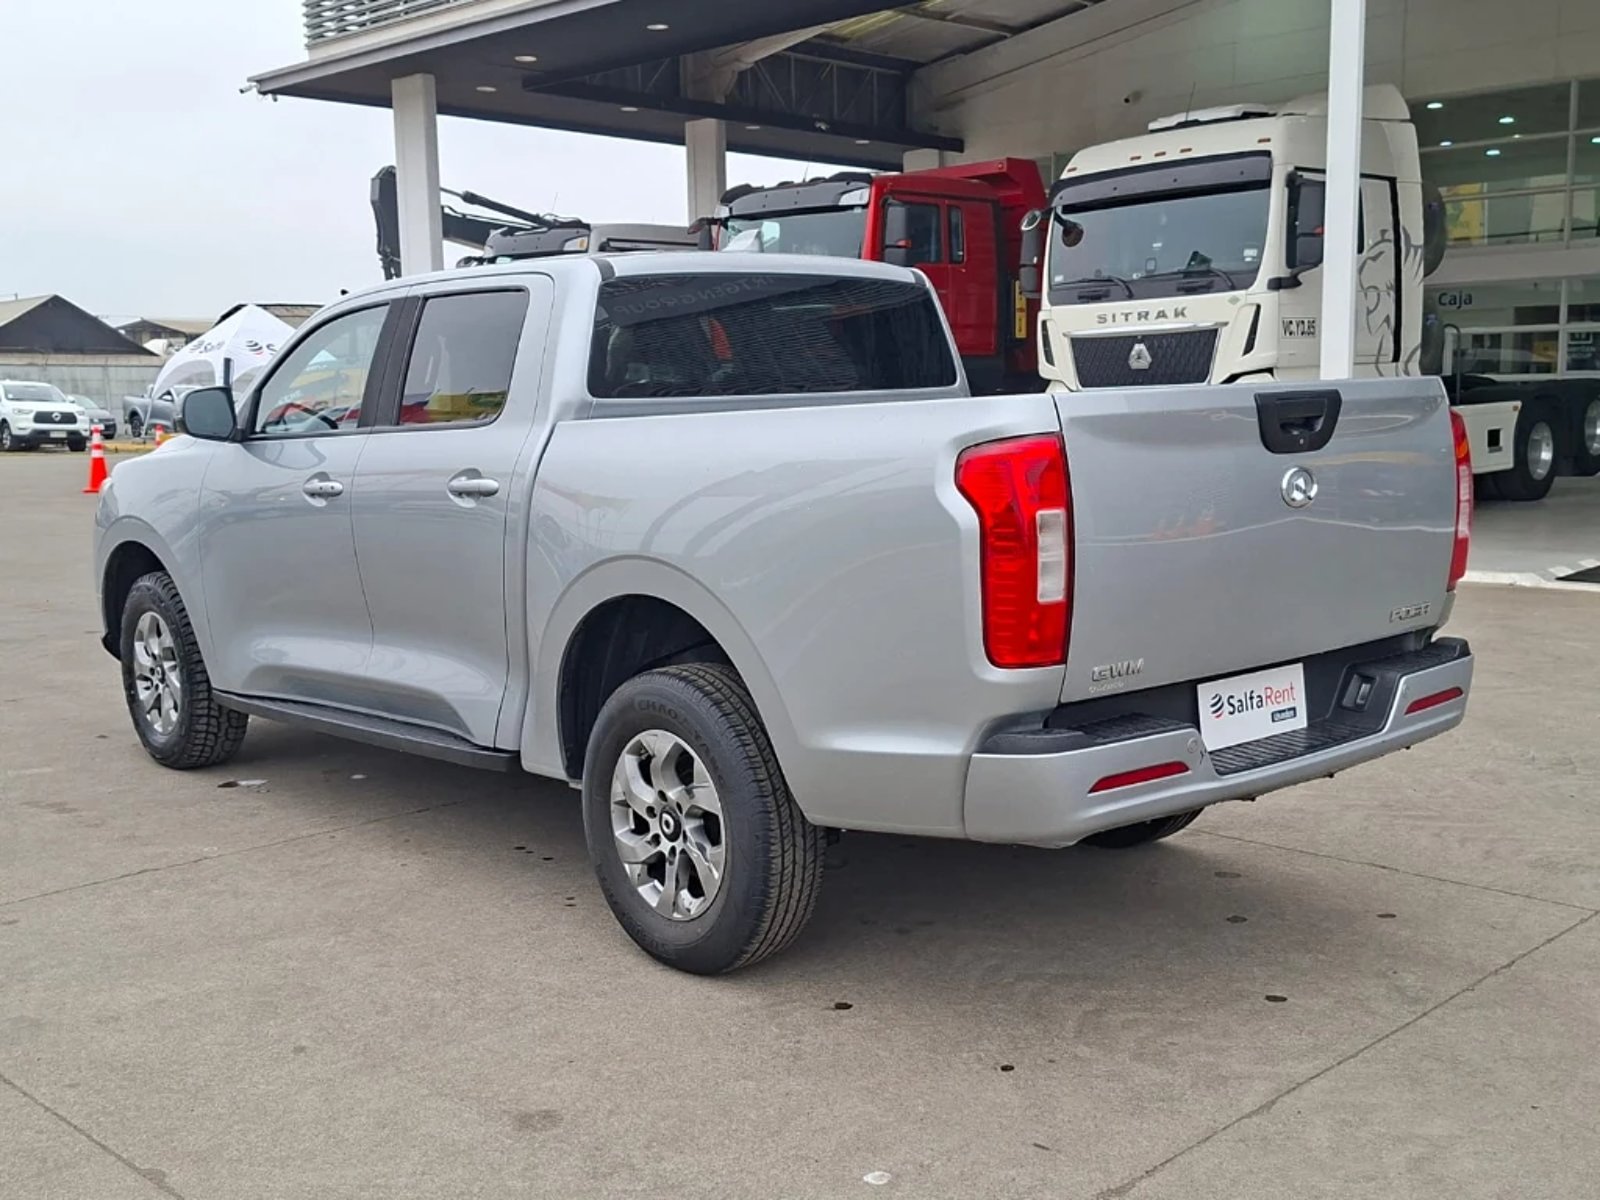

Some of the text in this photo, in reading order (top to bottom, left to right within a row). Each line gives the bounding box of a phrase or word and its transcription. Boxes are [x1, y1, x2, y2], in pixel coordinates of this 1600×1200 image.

[1439, 290, 1472, 310] Caja
[1096, 306, 1188, 325] SITRAK
[1092, 657, 1145, 682] GWM
[1226, 681, 1297, 716] SalfaRent
